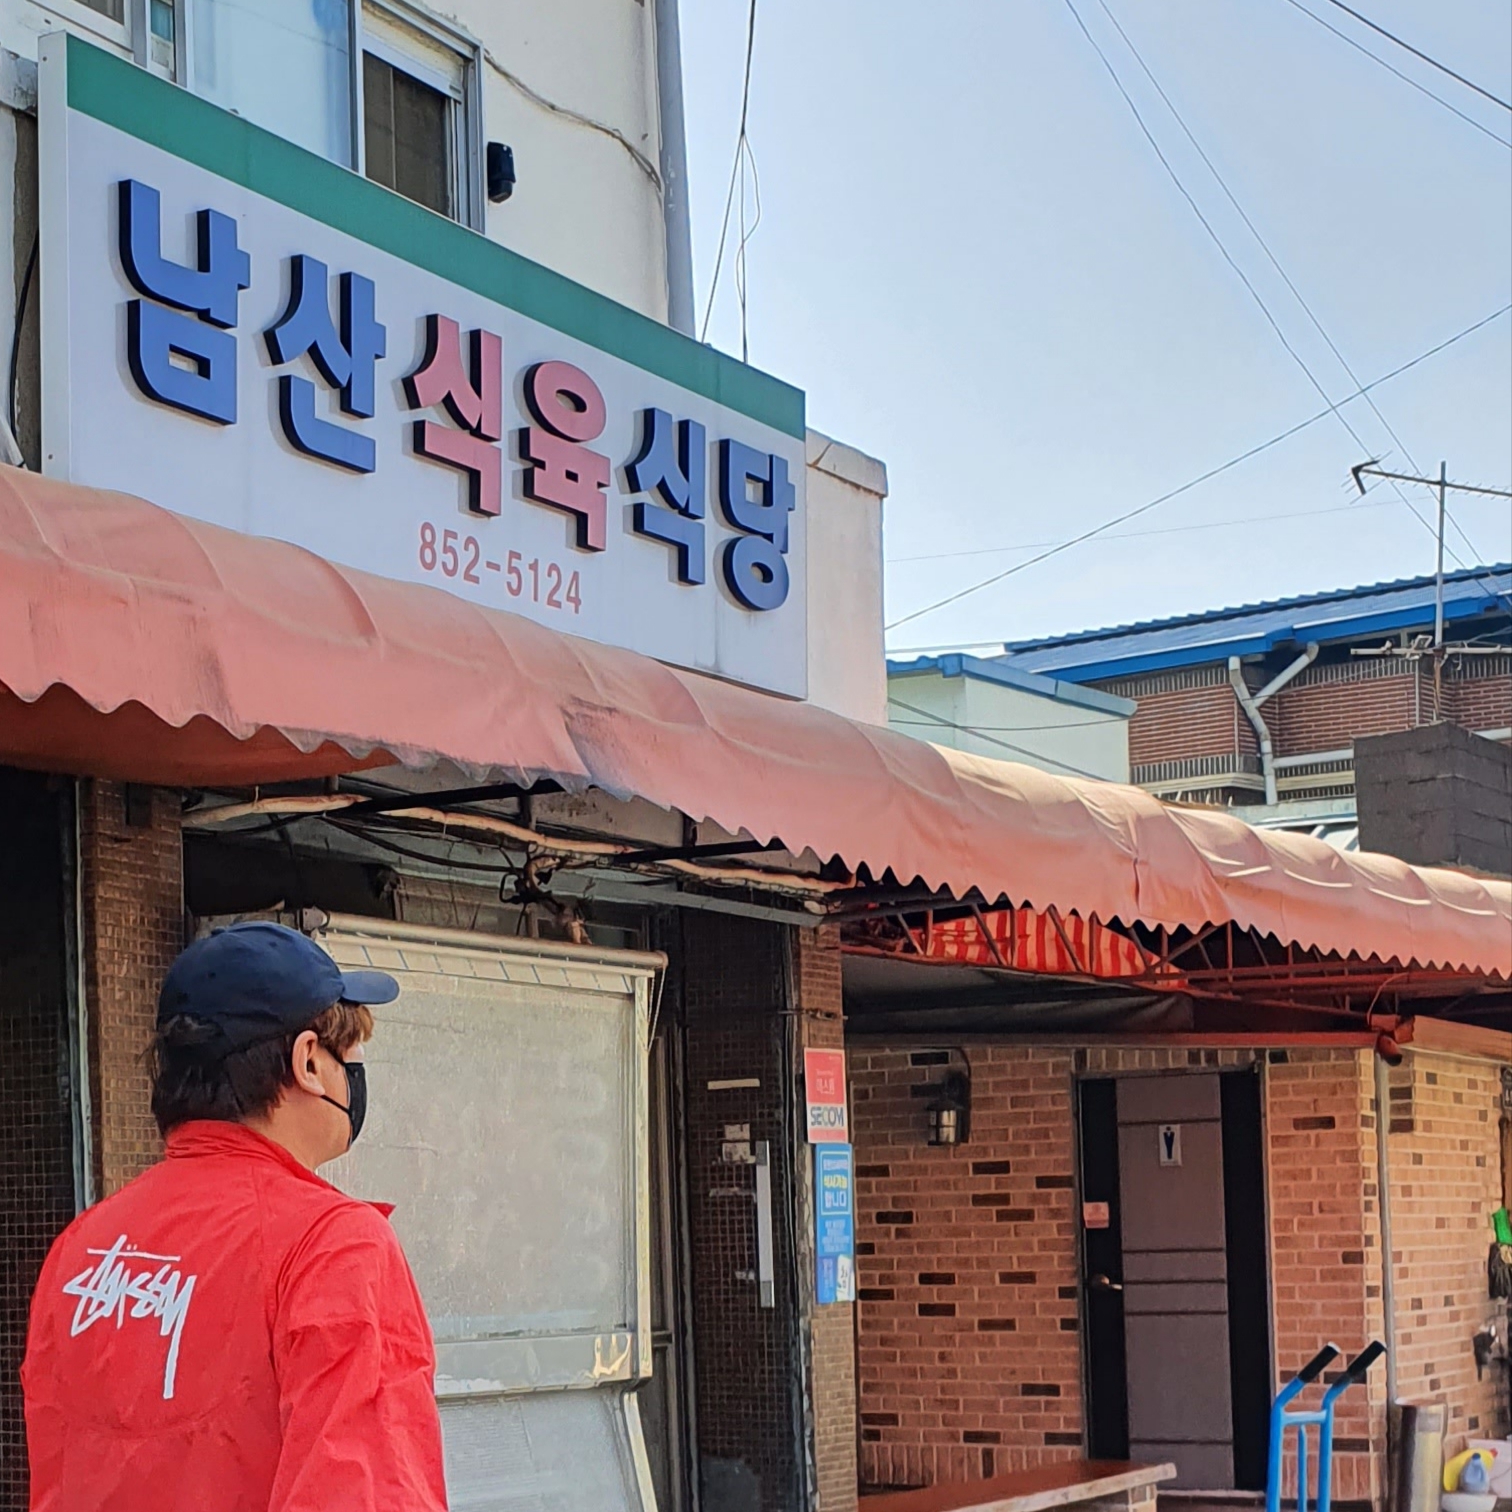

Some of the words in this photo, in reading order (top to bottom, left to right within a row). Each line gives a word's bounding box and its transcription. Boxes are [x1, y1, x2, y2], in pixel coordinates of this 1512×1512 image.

[117, 178, 796, 612] 남산식육식당
[418, 521, 583, 615] 852-5124
[810, 1106, 845, 1127] SECOM
